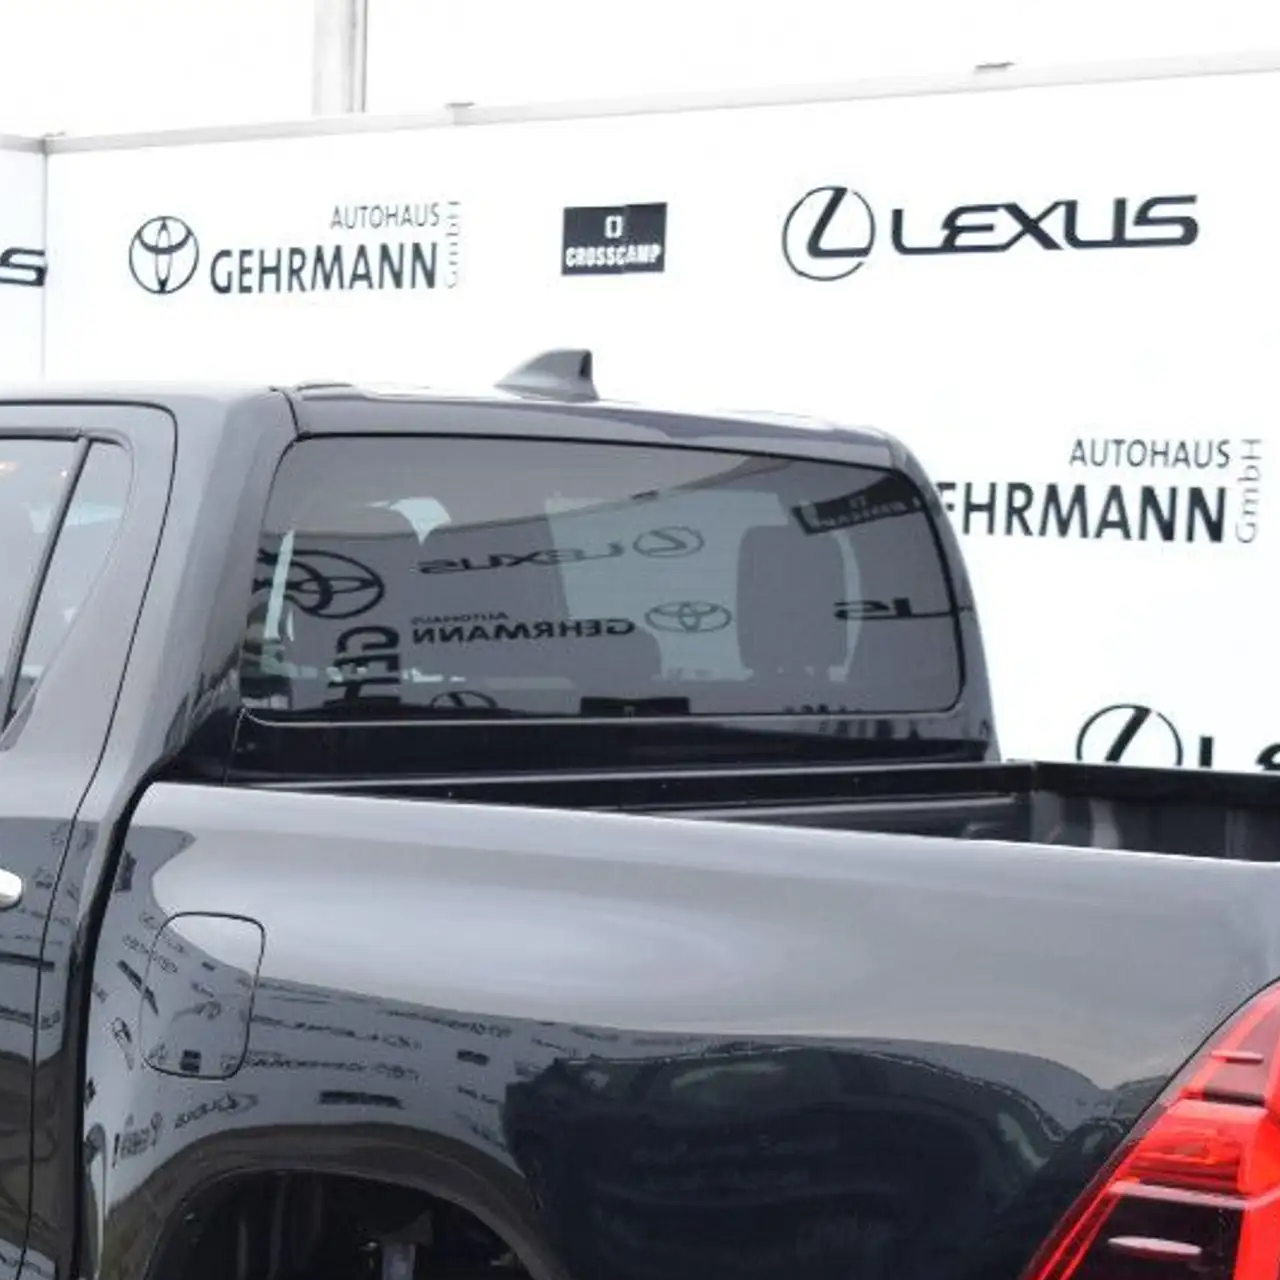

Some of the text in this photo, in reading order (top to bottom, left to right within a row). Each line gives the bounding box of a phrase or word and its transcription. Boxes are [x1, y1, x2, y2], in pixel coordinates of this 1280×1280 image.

[330, 201, 440, 230] AUTOHAUS
[891, 194, 1199, 256] LEXUS
[210, 242, 438, 295] GEHRMANN
[445, 200, 461, 290] GmbH
[565, 243, 662, 268] CROSSCAMP
[1069, 438, 1231, 470] AUTOHAUS
[1235, 438, 1262, 544] GmbH
